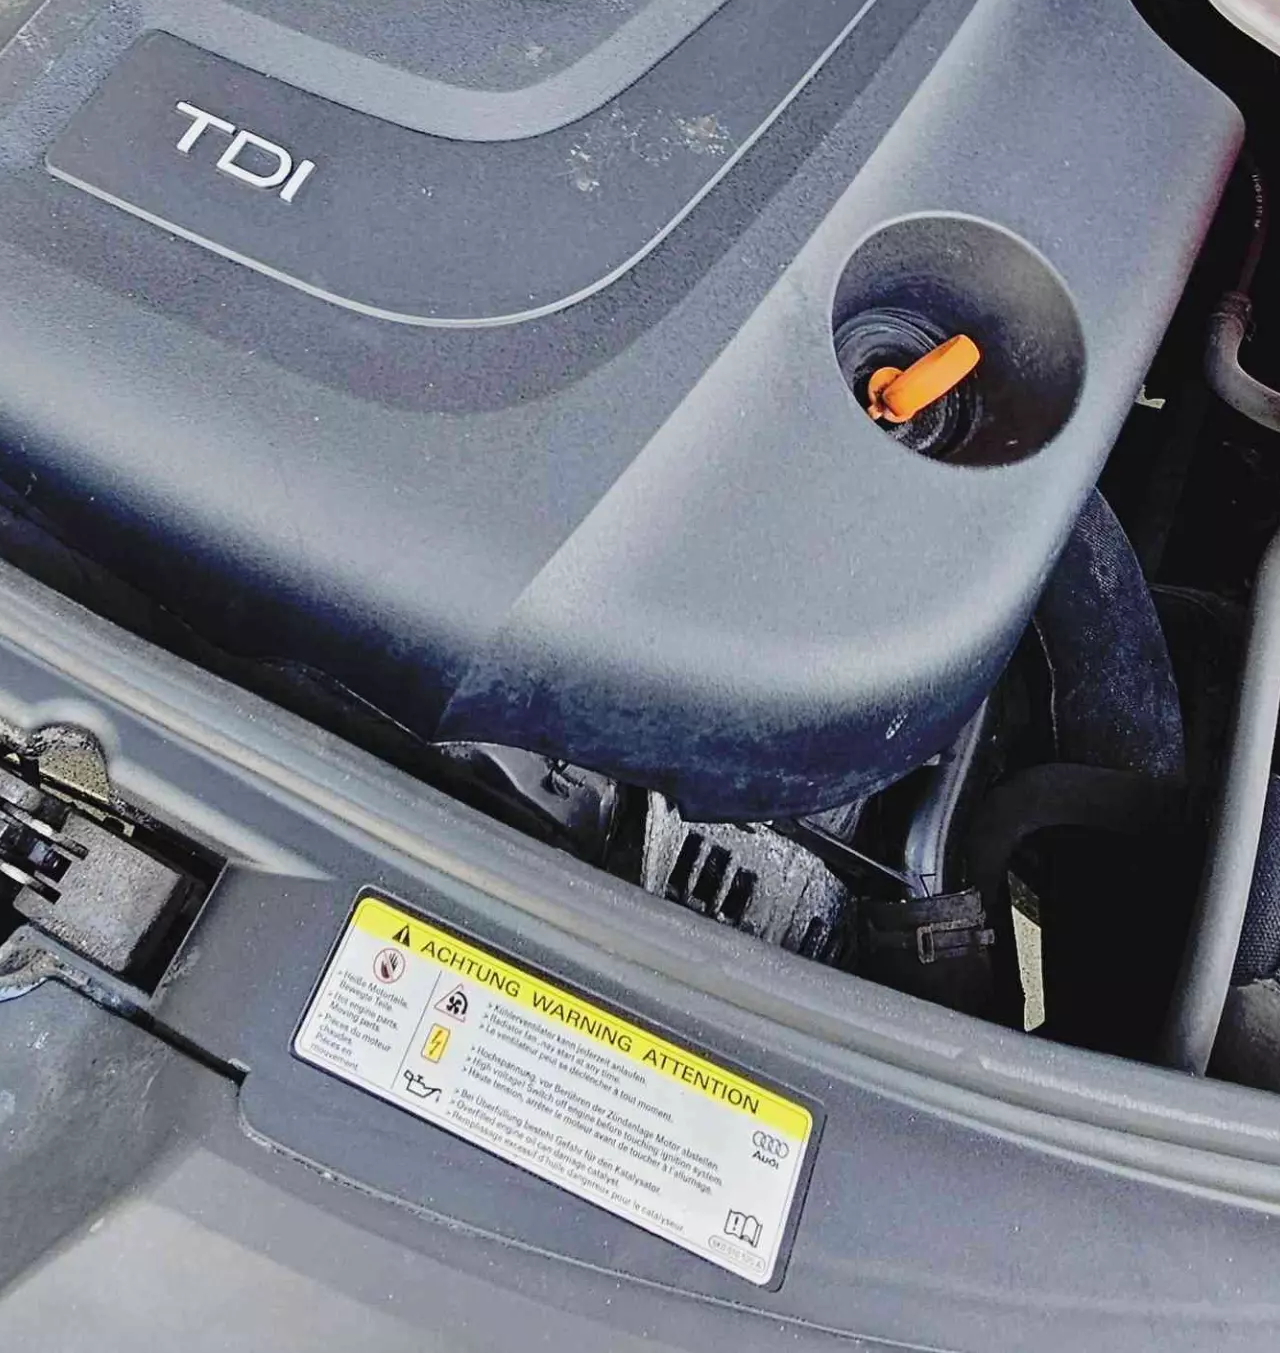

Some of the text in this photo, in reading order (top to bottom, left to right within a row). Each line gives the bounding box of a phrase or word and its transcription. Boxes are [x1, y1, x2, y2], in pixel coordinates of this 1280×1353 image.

[175, 99, 317, 204] TDI
[328, 1000, 361, 1023] Moving
[333, 991, 349, 1005] Hot
[348, 1000, 376, 1020] engine
[338, 980, 373, 1003] Bewegte
[419, 938, 760, 1114] ACHTUNG WARNING ATTENTION
[340, 1046, 353, 1057] en
[349, 1025, 363, 1037] du
[361, 1032, 392, 1053] moteur
[484, 1023, 496, 1036] Le
[618, 1089, 637, 1105] tout
[488, 1012, 523, 1036] Radiator
[523, 1029, 538, 1044] fan
[556, 1045, 575, 1062] start
[584, 1061, 600, 1075] any
[455, 1098, 496, 1125] Overfilled
[495, 1120, 524, 1141] engine
[536, 1141, 552, 1154] can
[552, 1147, 587, 1172] damage
[460, 1087, 475, 1101] Bei
[522, 1119, 554, 1141] besteht
[554, 1135, 583, 1156] Gefahr
[583, 1149, 596, 1163] für
[596, 1156, 613, 1172] den
[467, 1066, 492, 1085] Haute
[562, 1114, 593, 1136] moteur
[593, 1128, 617, 1147] avant
[617, 1140, 629, 1153] de
[628, 1146, 660, 1169] toucher
[471, 1056, 491, 1074] High
[525, 1082, 555, 1104] Switch
[553, 1096, 567, 1110] off
[566, 1104, 595, 1125] engine
[595, 1117, 623, 1138] before
[621, 1130, 659, 1157] touching
[658, 1148, 692, 1173] ignition
[537, 1077, 553, 1090] vor
[553, 1082, 592, 1109] Berühren
[591, 1101, 606, 1116] der
[654, 1132, 680, 1153] Motor
[451, 1109, 503, 1144] Remplissage
[565, 1167, 609, 1197] dangereux
[610, 1191, 630, 1207] pour
[750, 1147, 781, 1170] Audi
